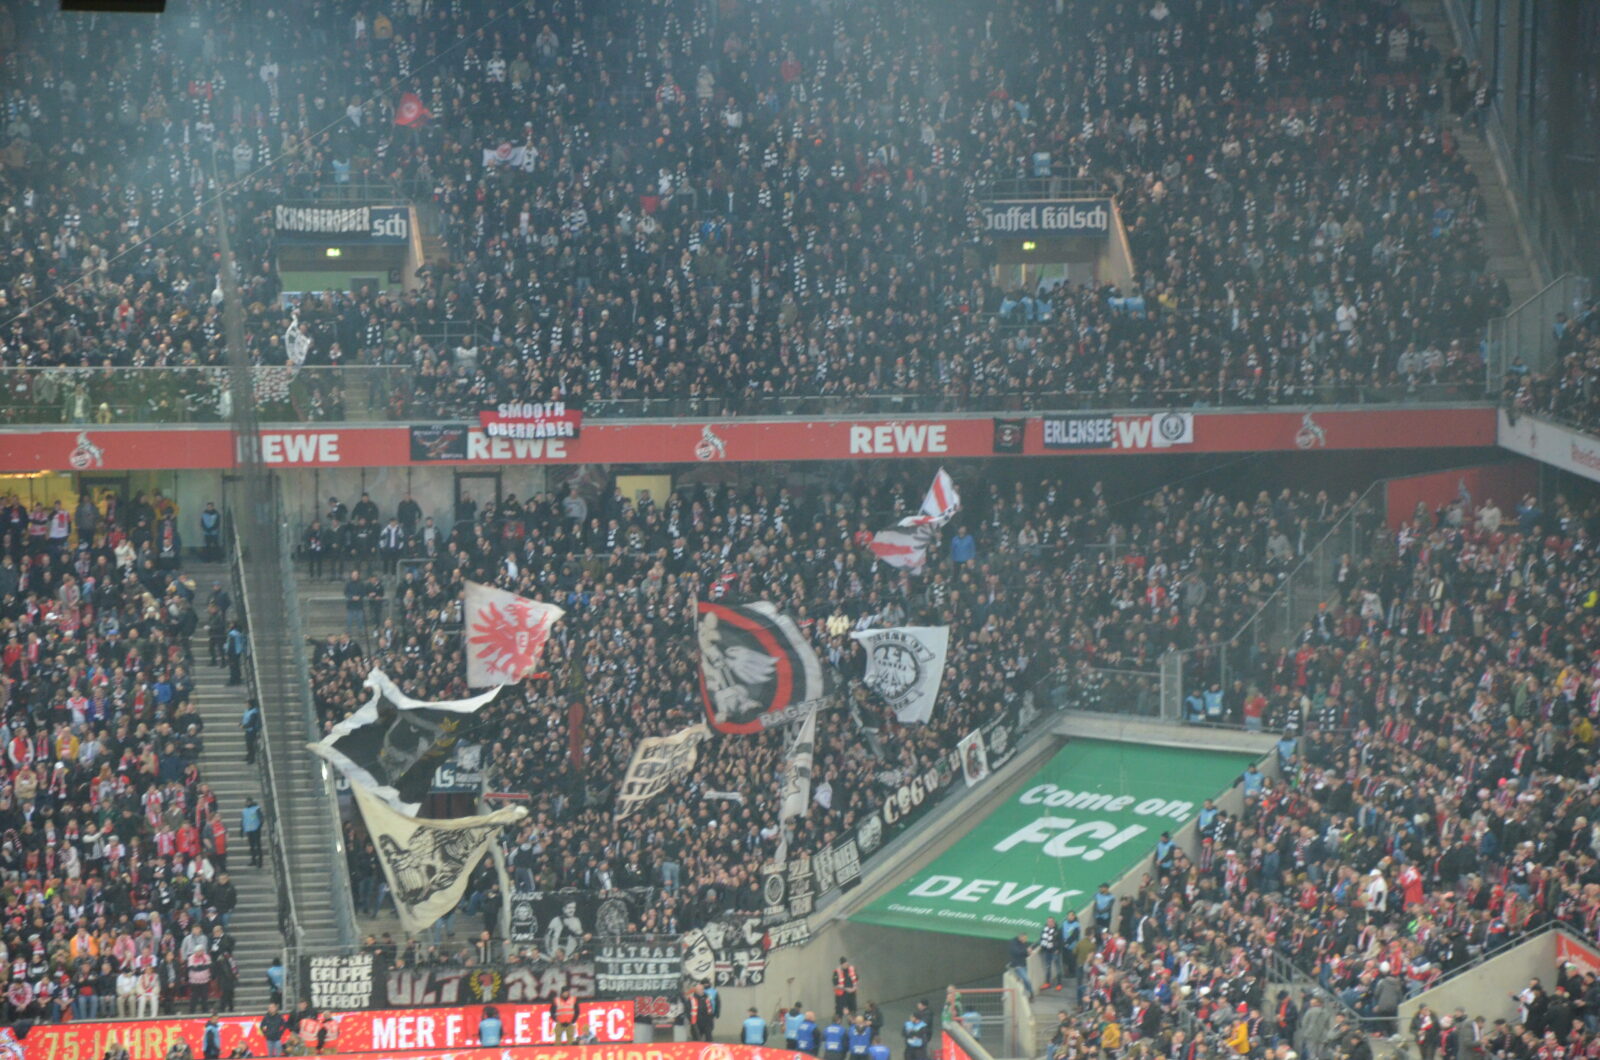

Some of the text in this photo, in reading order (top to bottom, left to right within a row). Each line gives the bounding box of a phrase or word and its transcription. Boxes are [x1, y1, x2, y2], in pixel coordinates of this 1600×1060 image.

[1042, 204, 1108, 231] Kölsch
[498, 402, 565, 418] SMOOTH
[850, 424, 948, 454] REWE
[1044, 418, 1112, 444] ERLENSEE
[1018, 783, 1195, 823] Come on,
[993, 816, 1148, 862] FC!
[908, 874, 1084, 913] DEVK
[602, 946, 675, 958] ULTRAS
[607, 962, 670, 975] NEVER
[598, 979, 678, 992] SURRENDER
[373, 1015, 435, 1050] MER
[589, 1007, 625, 1040] FC
[44, 1030, 80, 1060] 75
